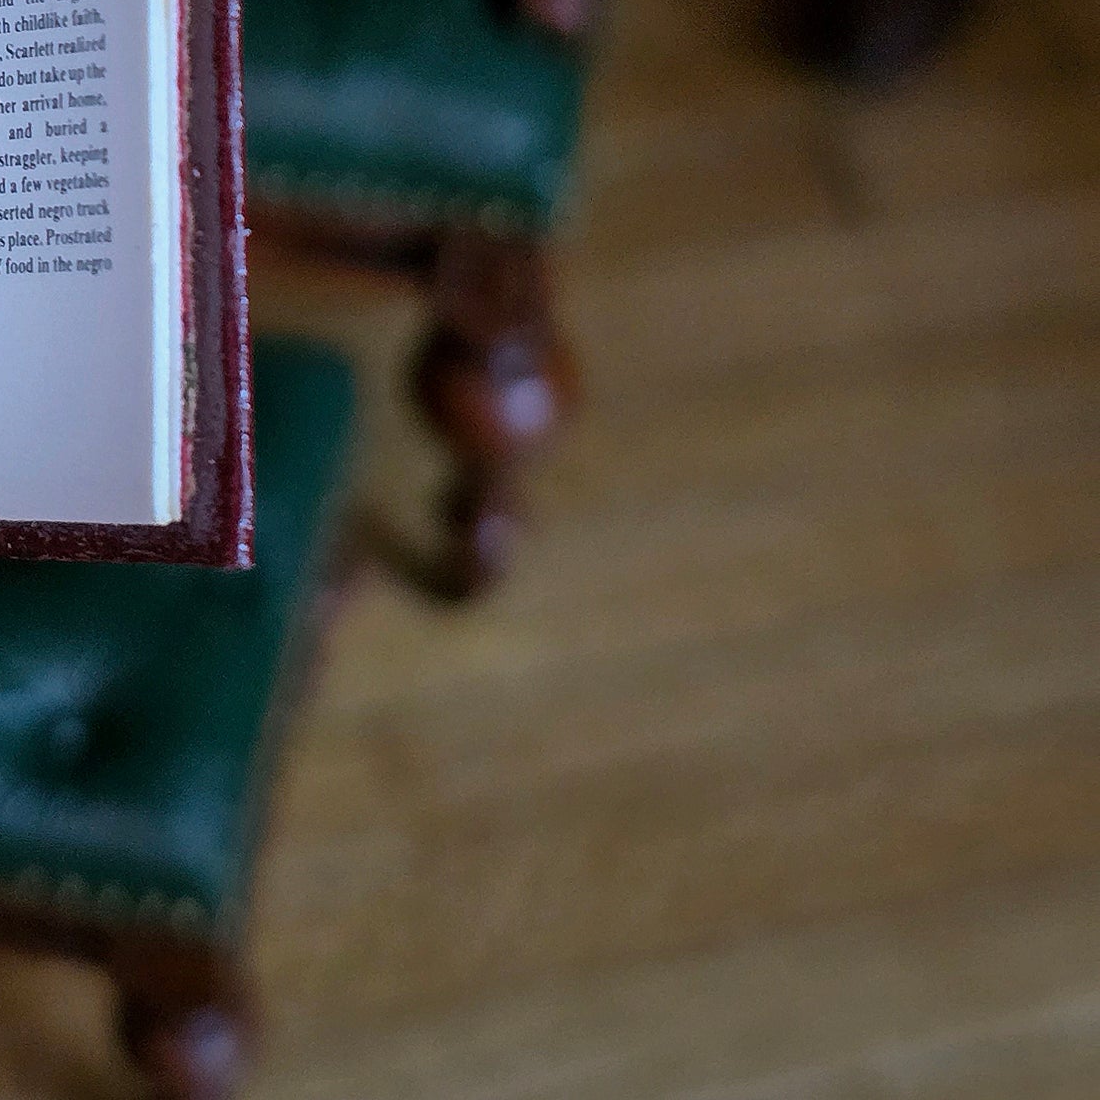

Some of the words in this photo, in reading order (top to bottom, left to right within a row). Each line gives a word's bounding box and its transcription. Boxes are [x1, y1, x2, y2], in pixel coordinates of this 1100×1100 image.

[14, 12, 69, 33] childlike
[5, 41, 54, 60] Scarlett
[17, 69, 38, 86] but
[40, 66, 66, 83] take
[68, 67, 85, 85] up
[86, 62, 107, 79] the
[22, 93, 63, 112] arrival
[8, 122, 33, 141] and
[45, 118, 88, 137] buried
[100, 120, 108, 133] a
[60, 144, 109, 166] keeping
[10, 180, 18, 193] a
[20, 175, 42, 192] few
[47, 171, 110, 195] vegetables
[38, 203, 74, 222] negro
[76, 199, 110, 216] truck
[7, 230, 43, 251] place.
[45, 226, 113, 246] Prostrated
[5, 256, 34, 274] food
[37, 256, 50, 273] in
[52, 255, 73, 272] the
[76, 255, 112, 274] negro
